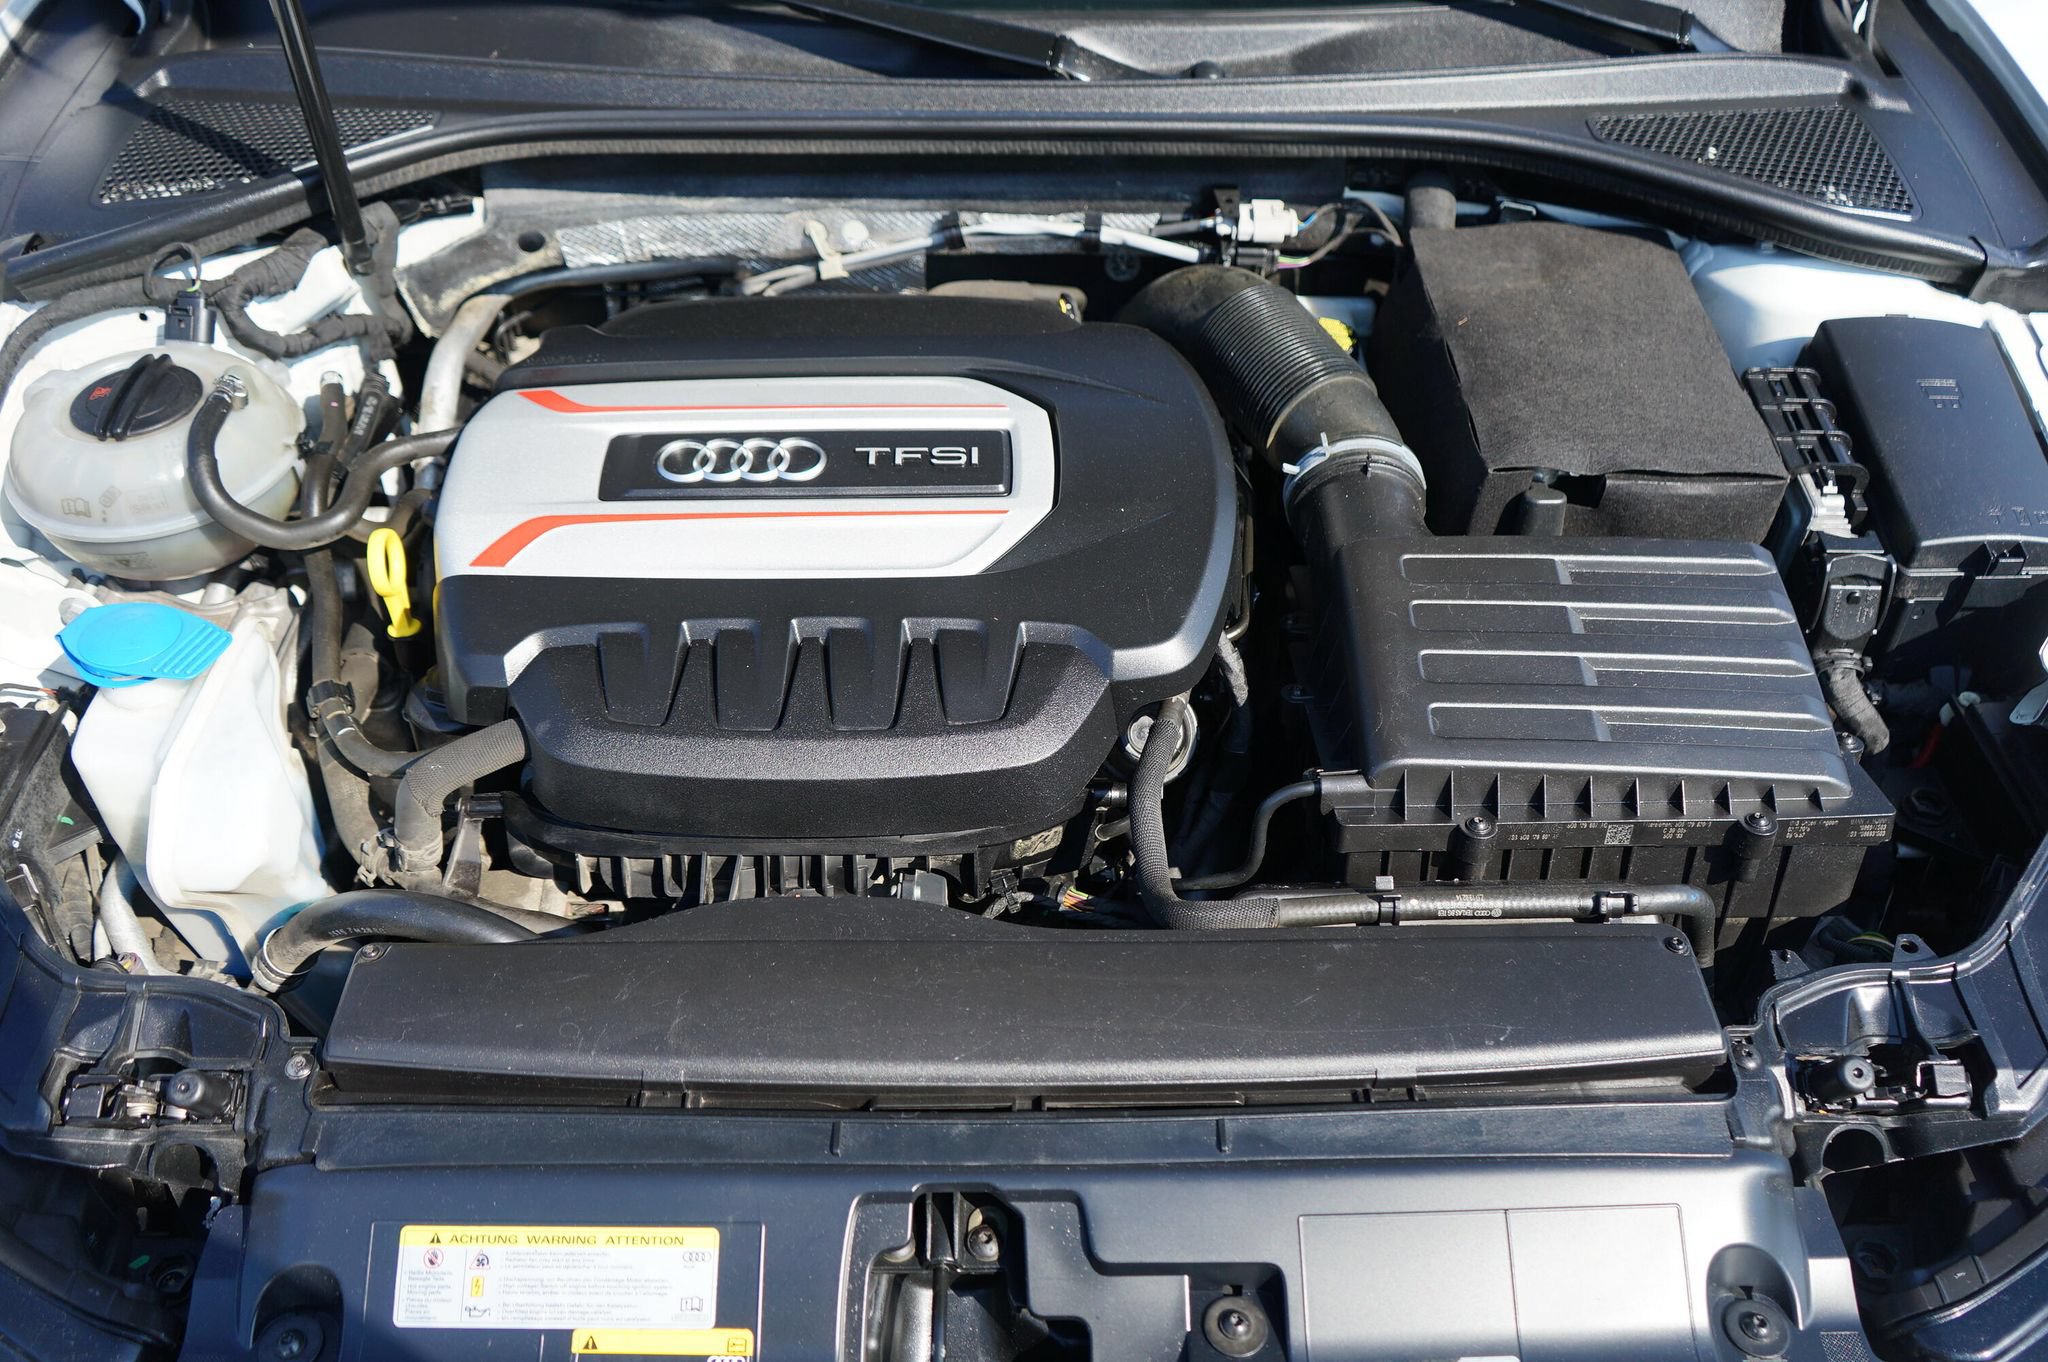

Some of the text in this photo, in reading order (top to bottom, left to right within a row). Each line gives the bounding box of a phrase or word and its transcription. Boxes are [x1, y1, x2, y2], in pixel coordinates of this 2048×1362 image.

[855, 446, 979, 465] TFSI
[449, 1234, 684, 1246] ACHTUNG WARNING ATTENTION
